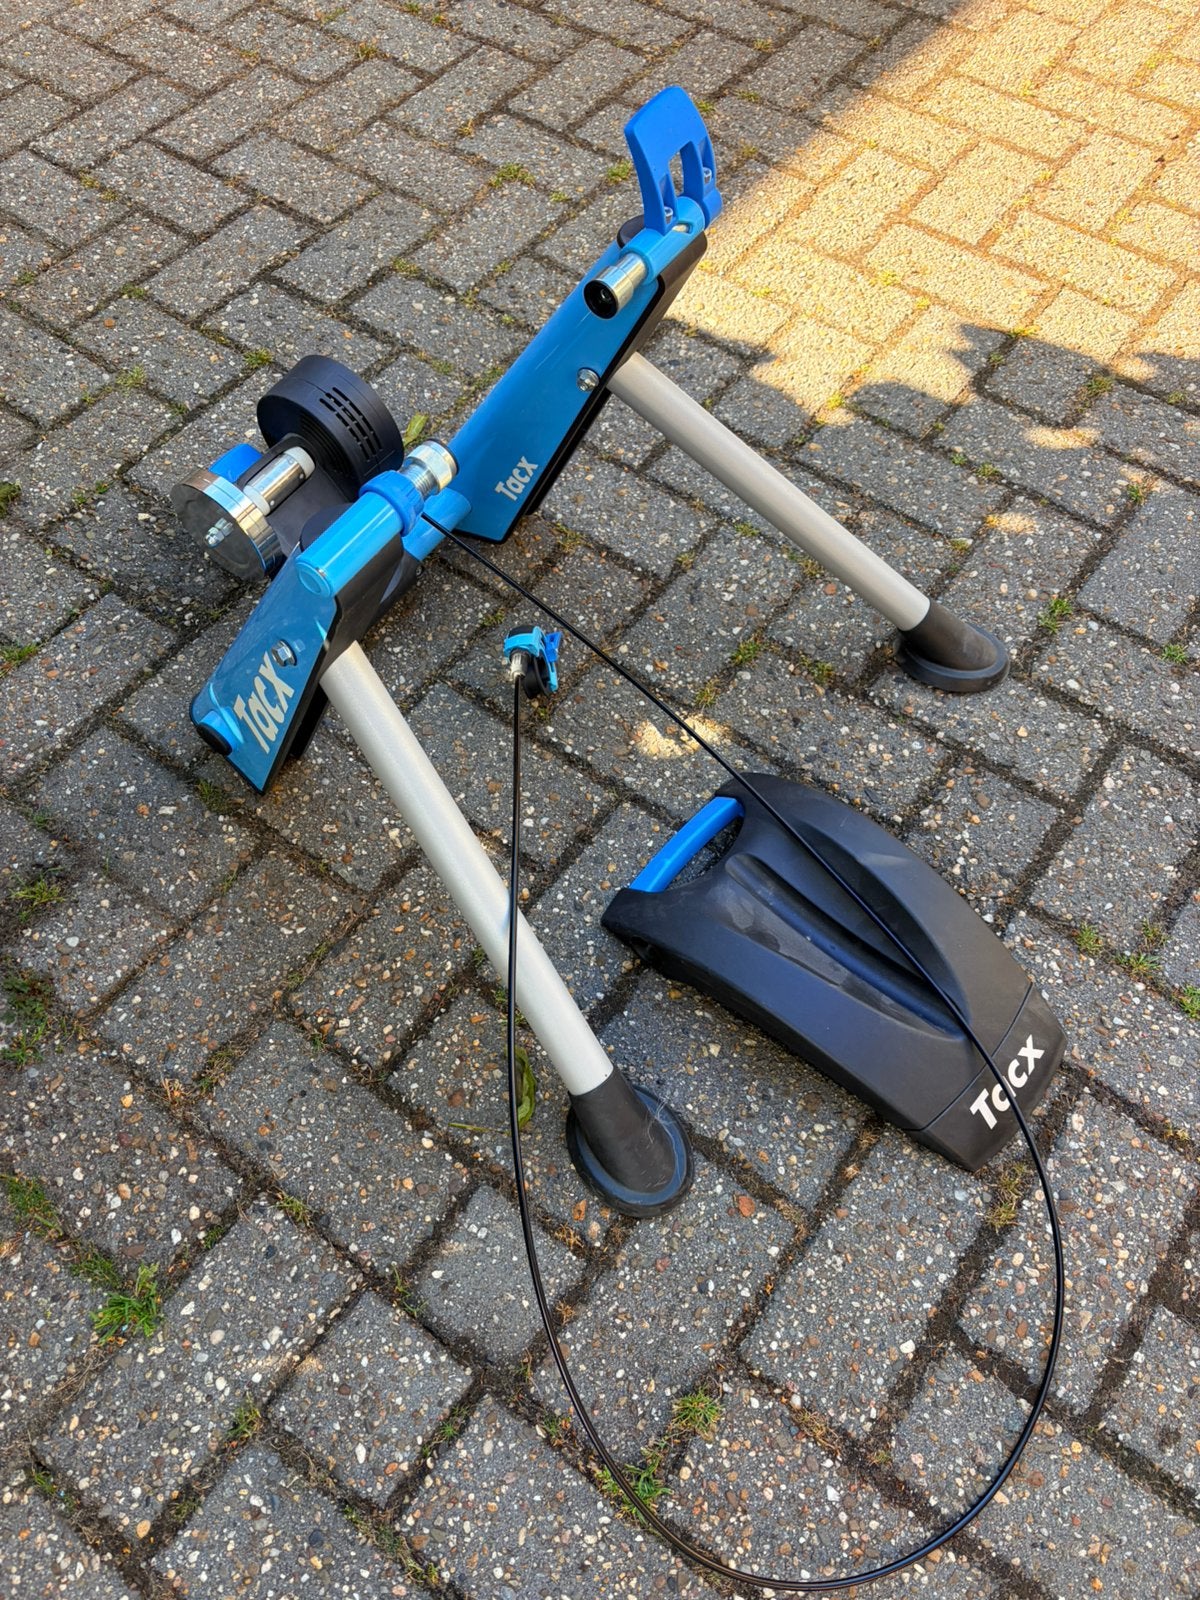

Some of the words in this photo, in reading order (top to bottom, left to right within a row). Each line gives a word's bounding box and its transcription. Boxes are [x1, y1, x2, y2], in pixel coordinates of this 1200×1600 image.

[495, 456, 539, 501] Tacx
[233, 651, 295, 754] Tacx
[969, 1034, 1045, 1130] Tacx
